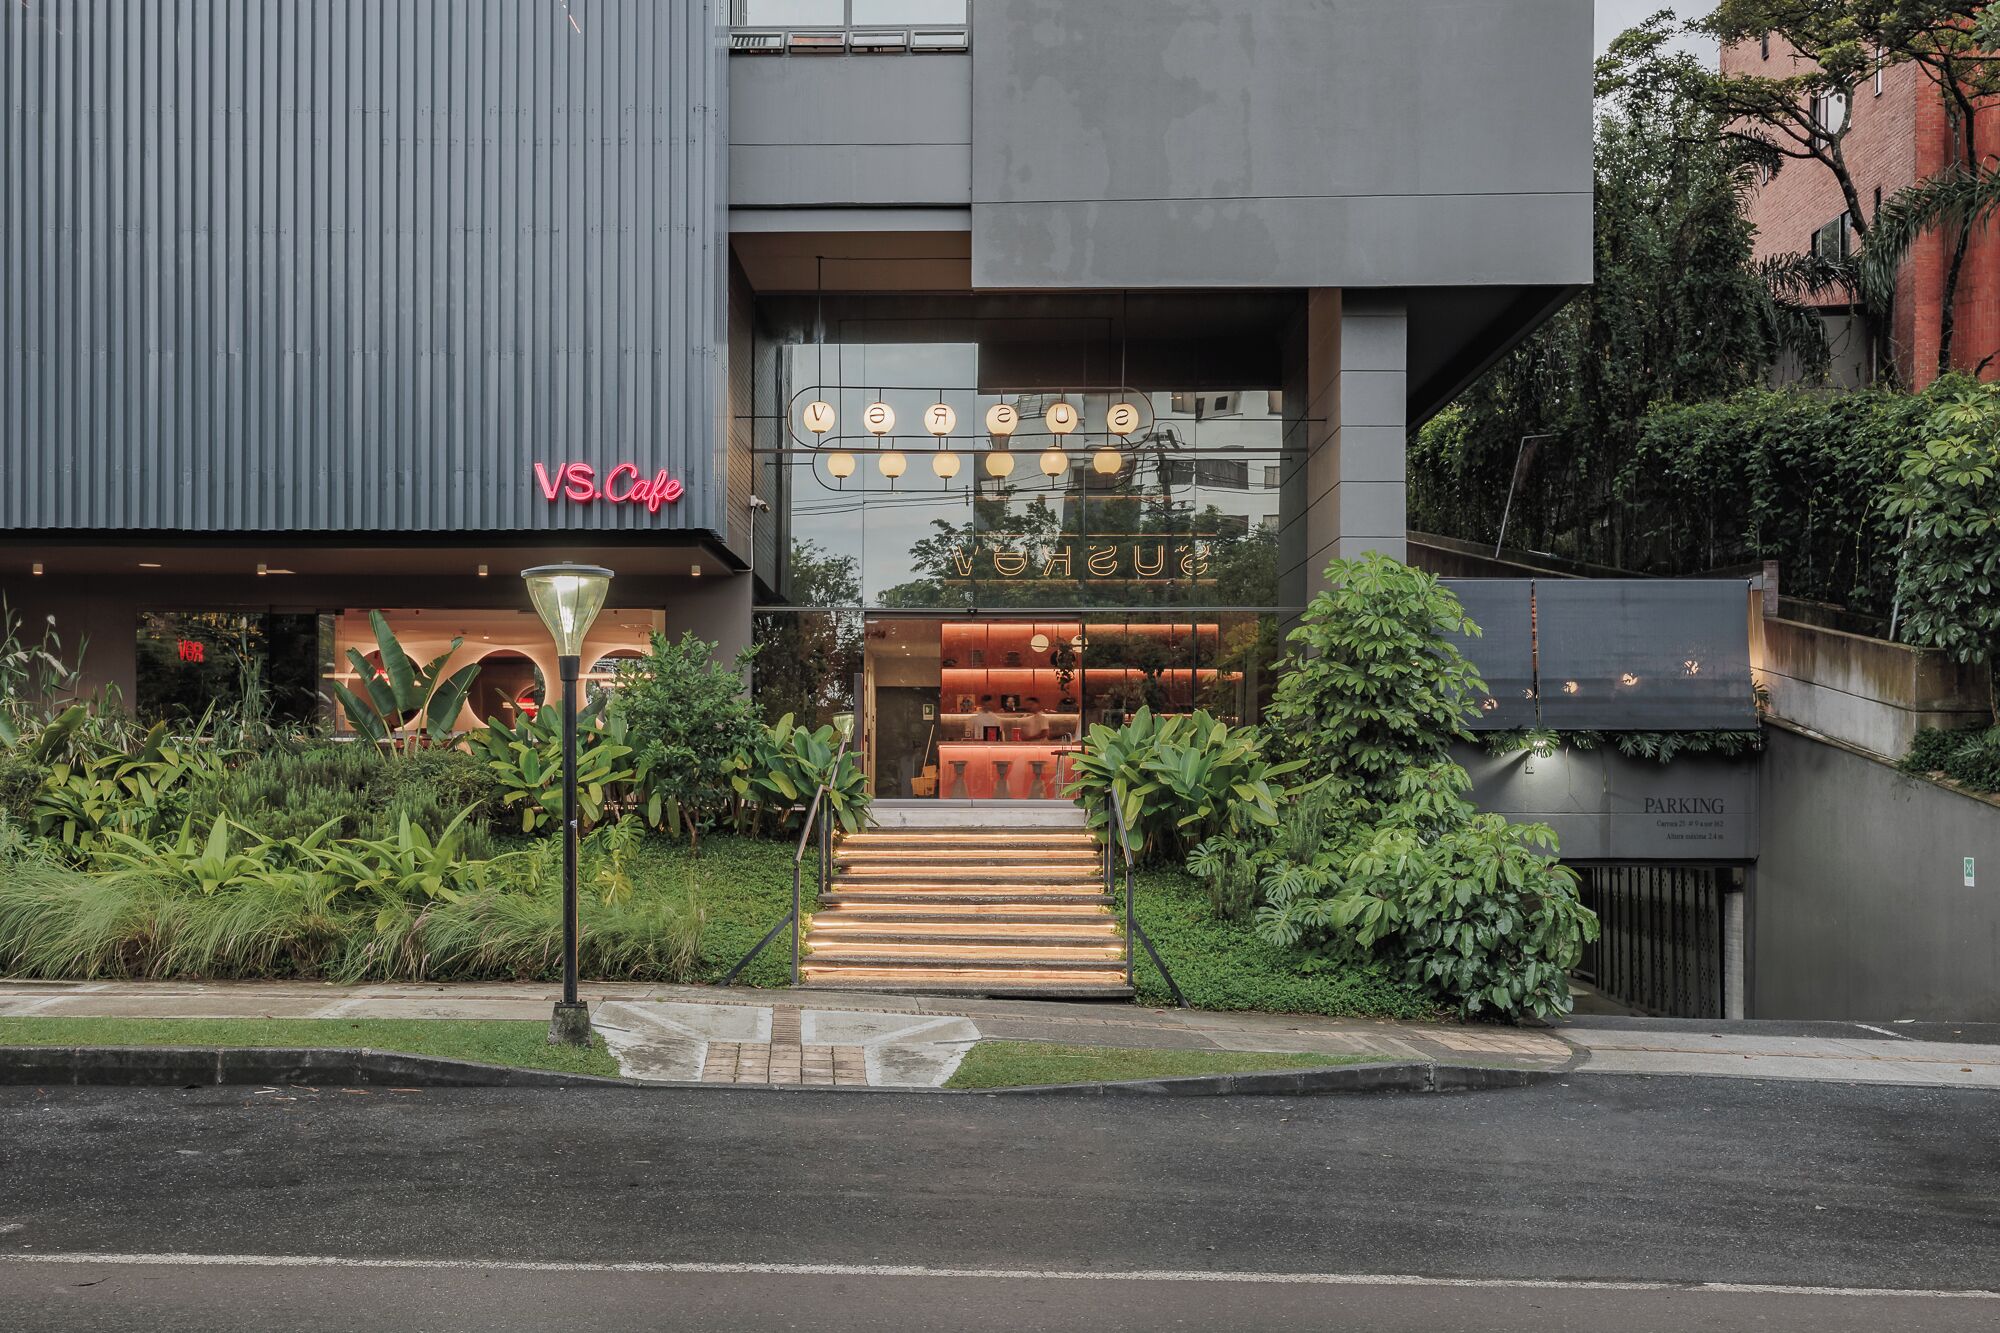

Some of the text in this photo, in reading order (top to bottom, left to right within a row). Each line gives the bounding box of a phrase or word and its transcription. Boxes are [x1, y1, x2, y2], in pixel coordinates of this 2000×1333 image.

[534, 462, 685, 512] VS. Cafe
[1644, 797, 1725, 814] PARKING
